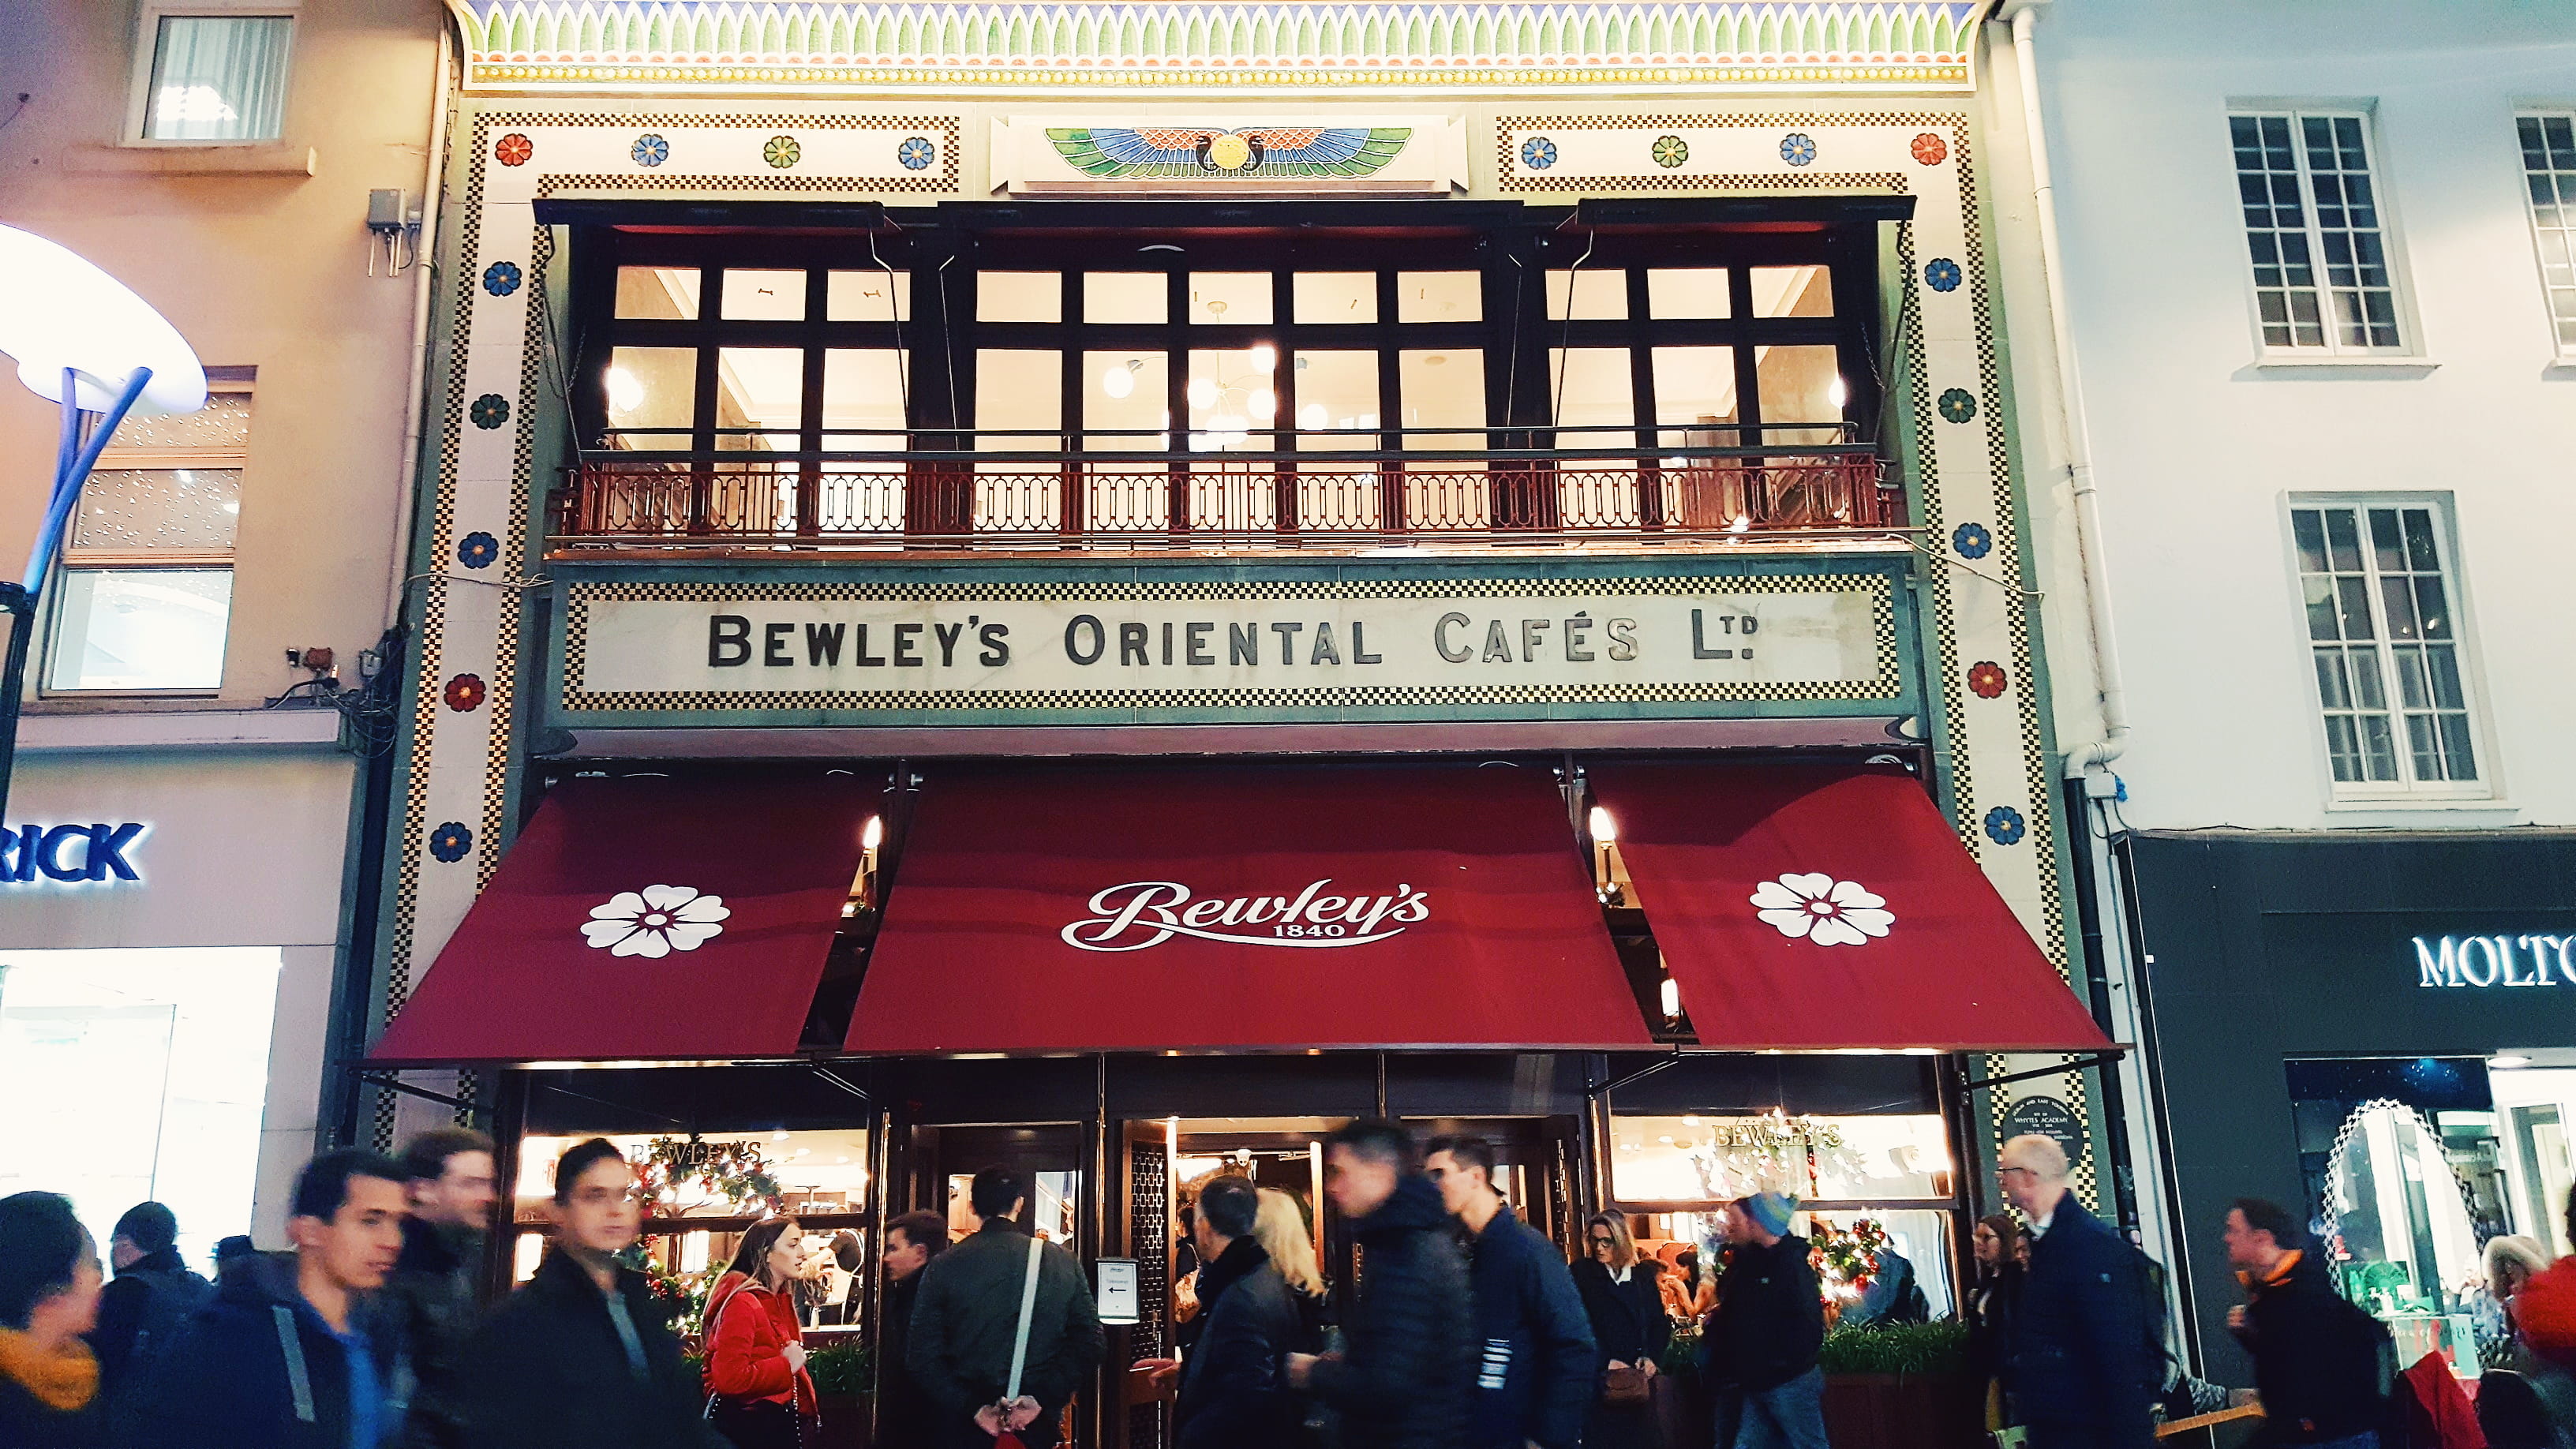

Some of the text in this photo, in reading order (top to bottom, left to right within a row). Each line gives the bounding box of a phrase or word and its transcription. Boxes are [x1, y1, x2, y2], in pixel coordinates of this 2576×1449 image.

[708, 615, 1010, 668] BEWLEY'S
[1064, 614, 1383, 666] ORIENTAL
[1434, 610, 1639, 664] CAFÉS
[1061, 878, 1430, 953] Bewley's
[1272, 924, 1346, 938] 1840
[631, 1140, 762, 1166] BWLEY'S
